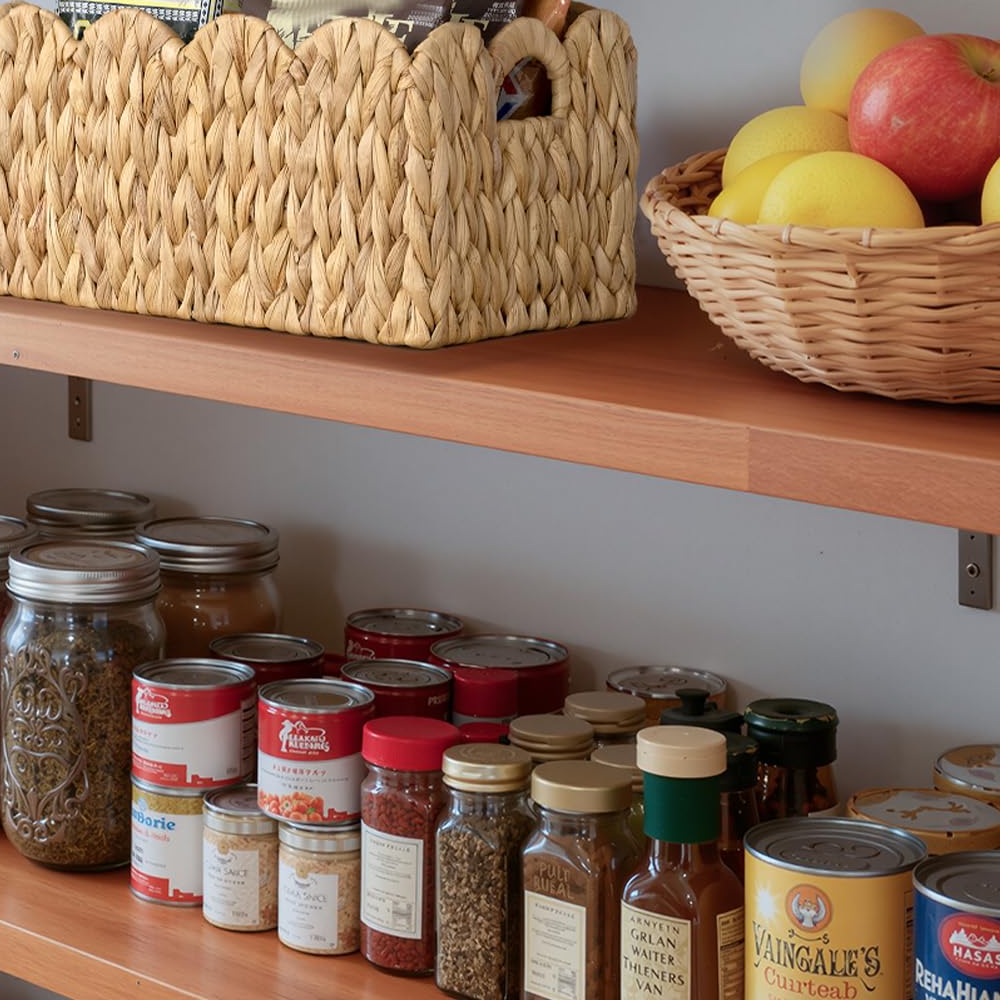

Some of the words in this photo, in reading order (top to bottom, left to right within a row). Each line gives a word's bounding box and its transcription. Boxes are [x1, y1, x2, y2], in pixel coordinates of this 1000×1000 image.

[630, 927, 677, 950] GRLAN
[631, 944, 676, 967] WAITER
[635, 978, 663, 997] VAN
